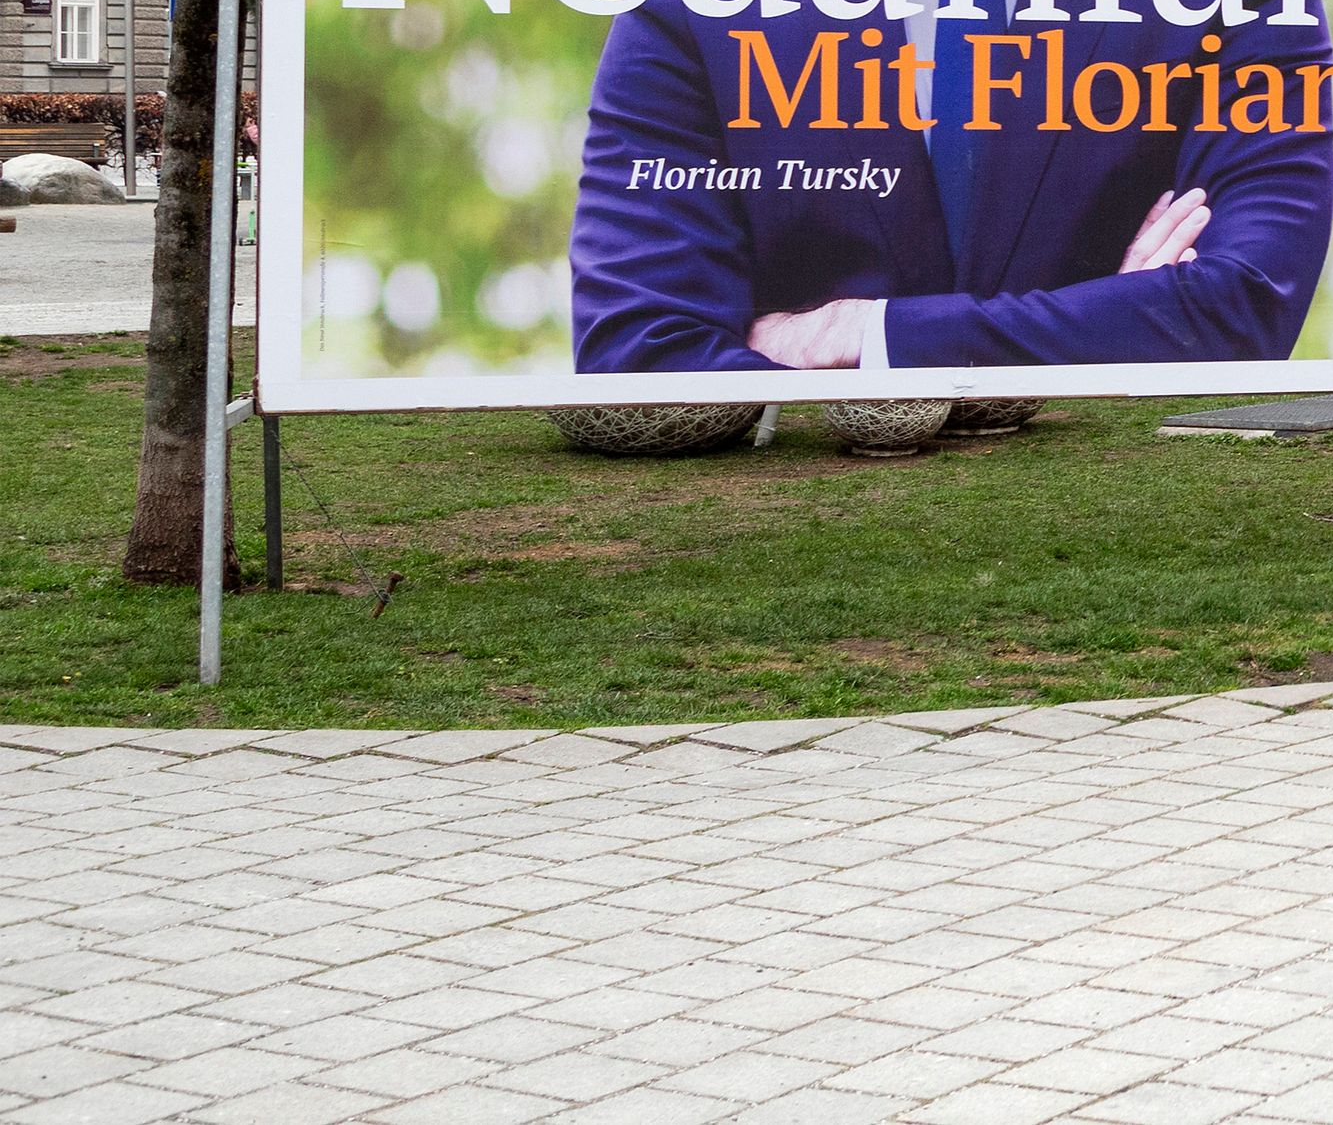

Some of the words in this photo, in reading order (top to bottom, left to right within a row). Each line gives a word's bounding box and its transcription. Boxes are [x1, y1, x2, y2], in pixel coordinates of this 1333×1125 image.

[727, 27, 939, 131] Mit
[625, 157, 762, 191] Florian
[776, 158, 901, 198] Tursky
